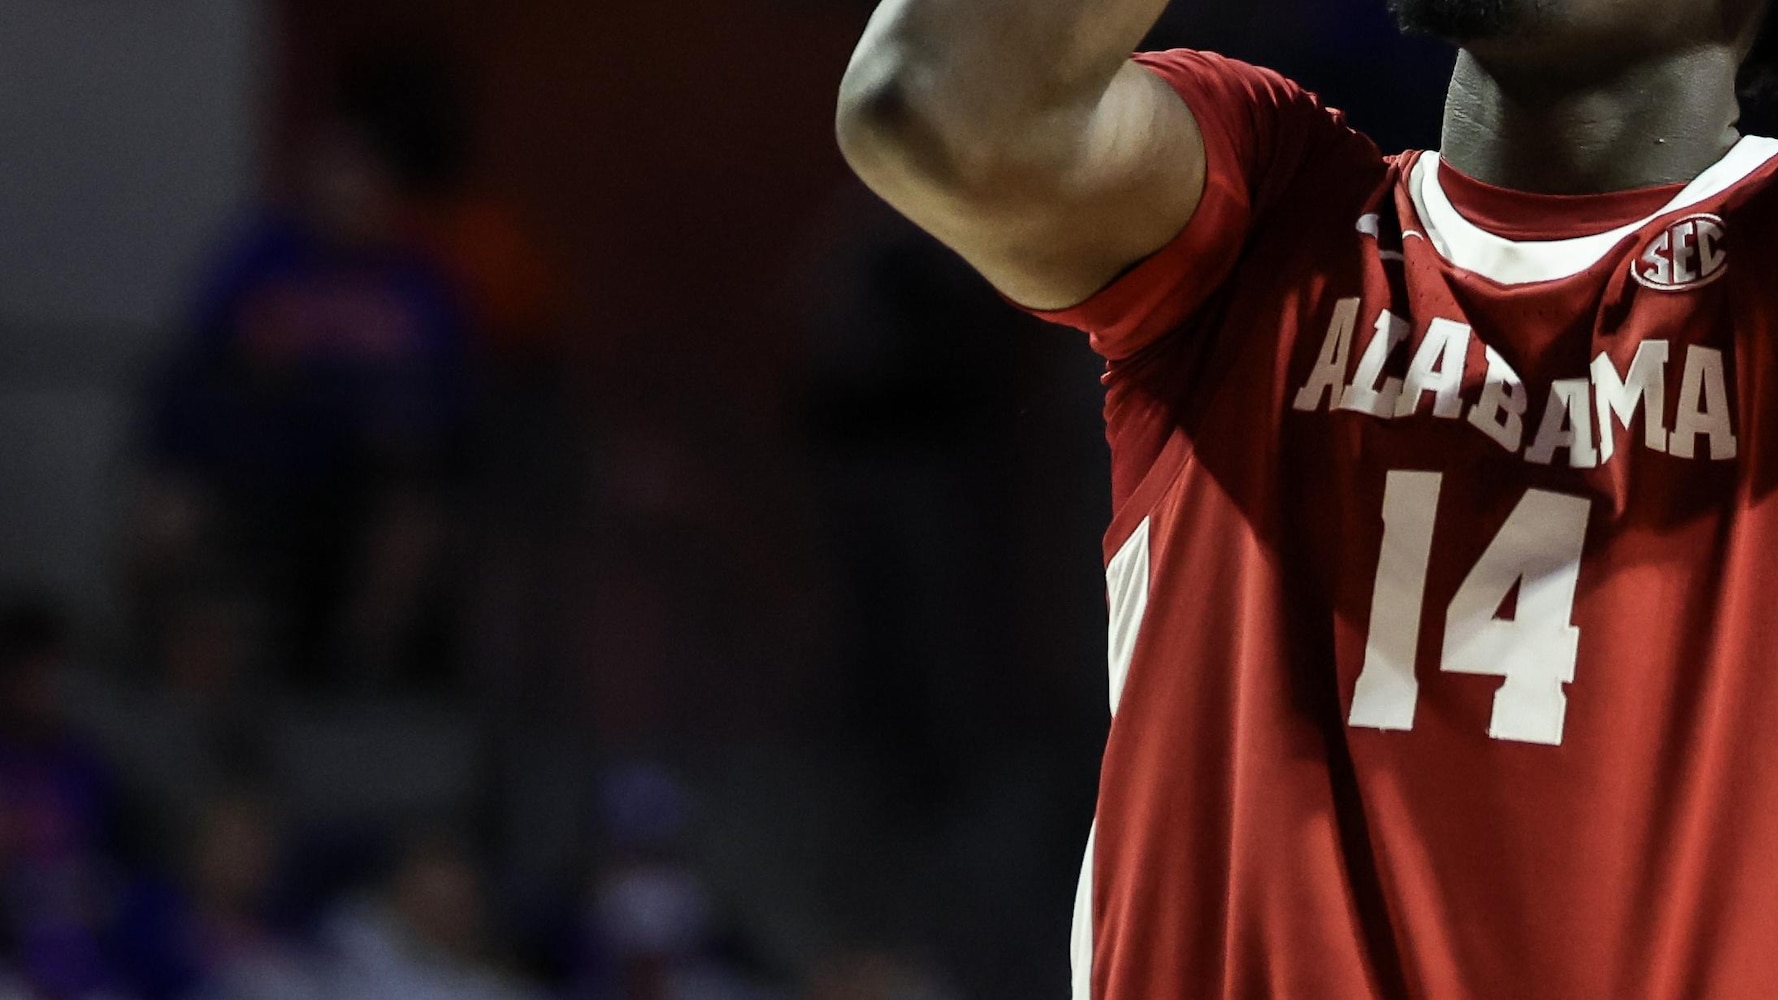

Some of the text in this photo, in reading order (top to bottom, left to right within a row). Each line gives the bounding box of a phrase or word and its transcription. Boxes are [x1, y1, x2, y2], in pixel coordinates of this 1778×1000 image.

[1641, 219, 1727, 284] SEC
[1293, 297, 1737, 468] ALABAMA
[1348, 469, 1592, 746] 14
